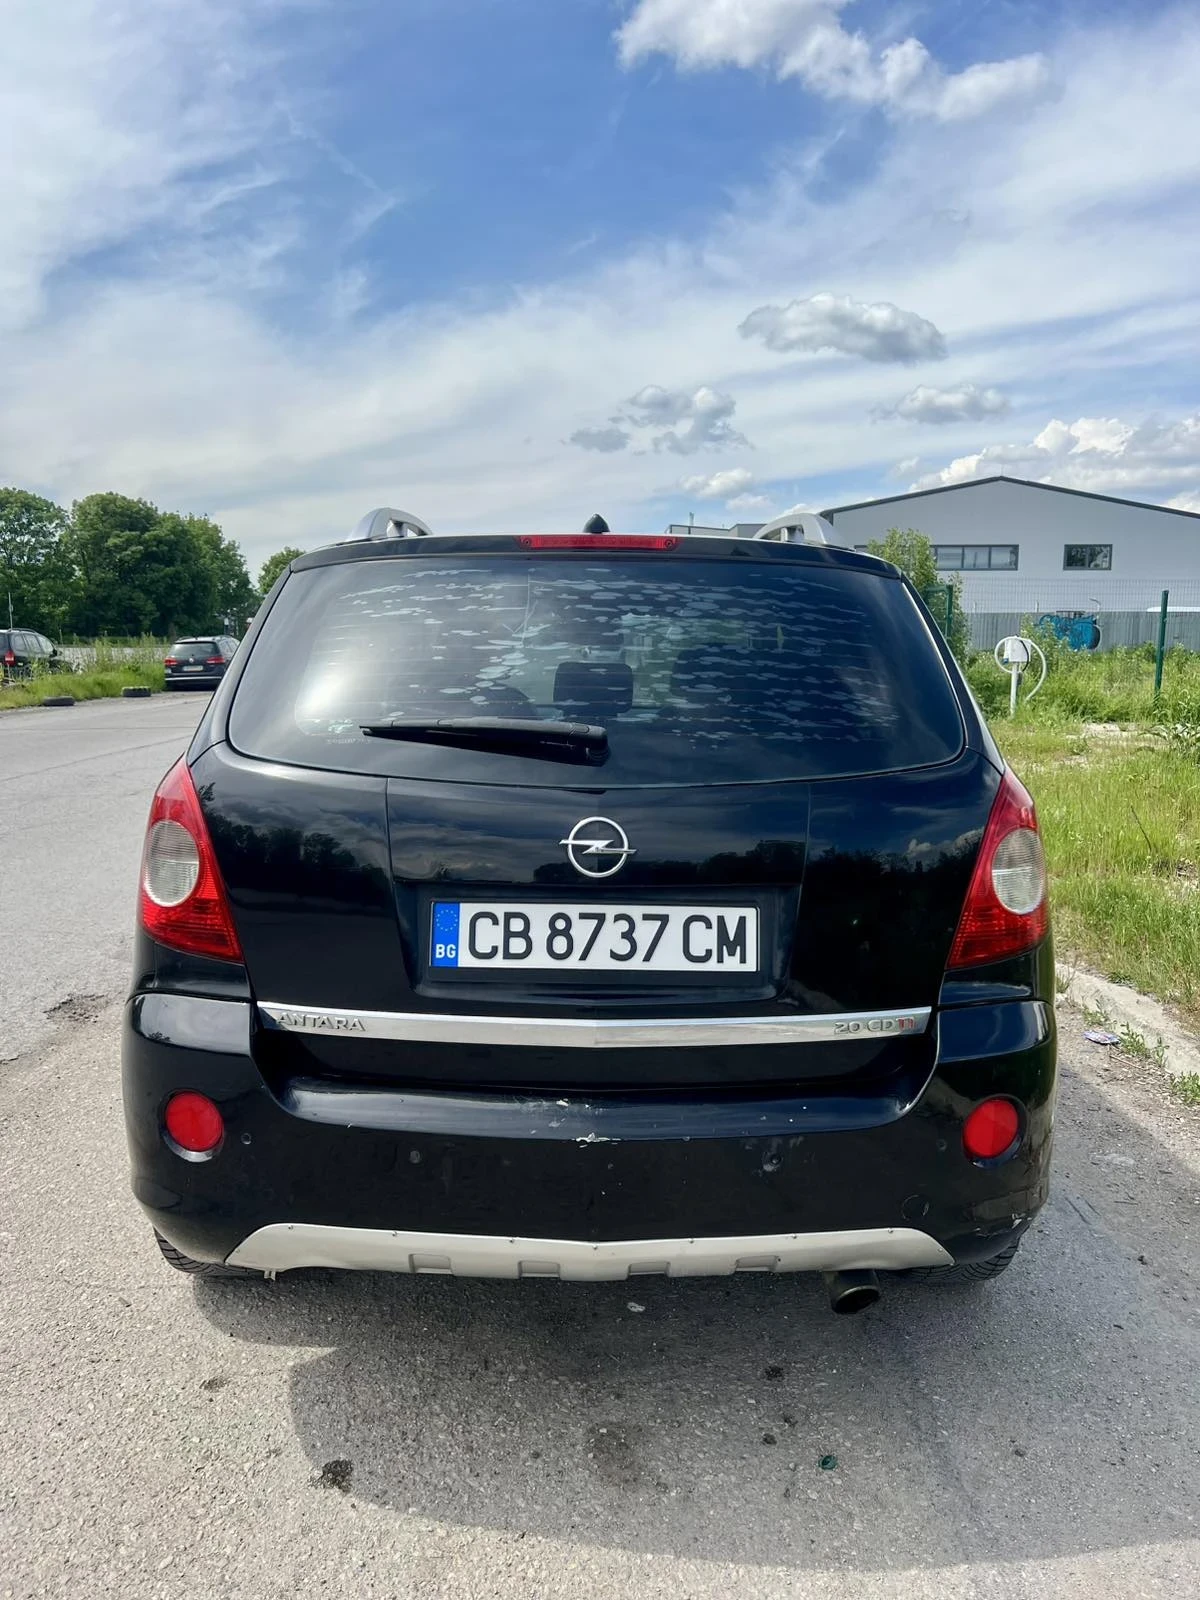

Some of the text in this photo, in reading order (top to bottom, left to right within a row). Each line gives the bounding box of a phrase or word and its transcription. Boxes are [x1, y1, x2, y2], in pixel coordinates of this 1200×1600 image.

[468, 911, 747, 964] CB 8737 CM
[435, 944, 456, 958] BG
[278, 1012, 366, 1031] ANTARA
